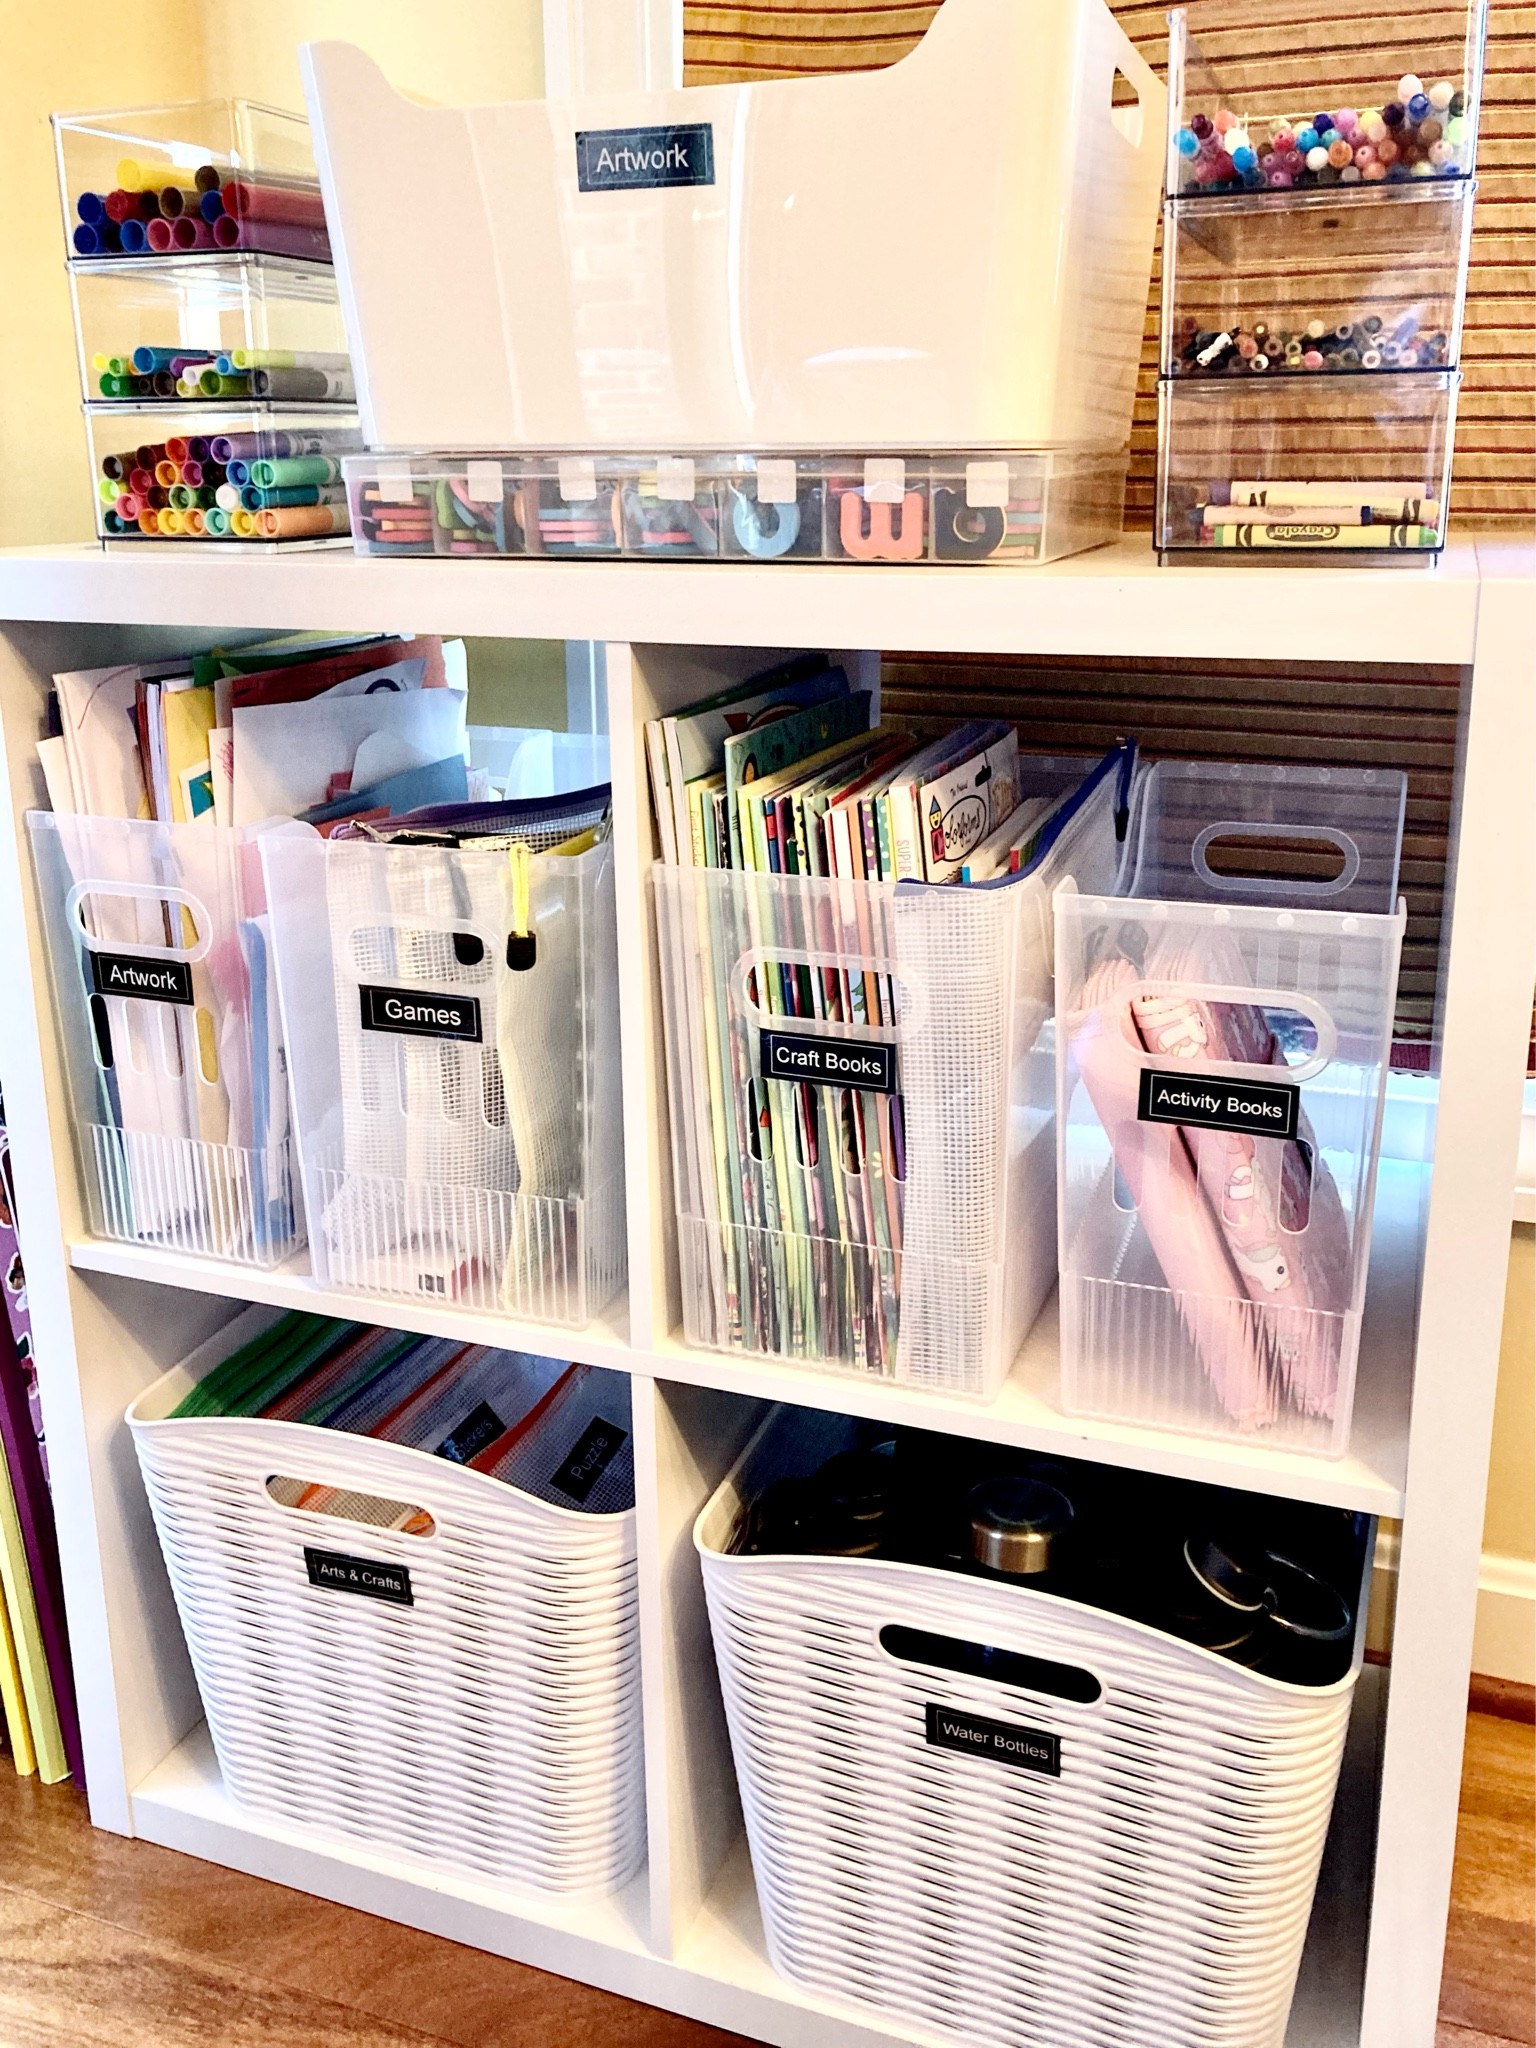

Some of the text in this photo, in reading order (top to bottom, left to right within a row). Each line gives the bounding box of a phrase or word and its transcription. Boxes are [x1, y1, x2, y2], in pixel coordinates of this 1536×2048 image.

[595, 142, 689, 173] Artwork
[109, 964, 178, 991] Artwork
[385, 999, 461, 1026] Games
[776, 1046, 882, 1075] Craft Books
[1157, 1089, 1283, 1118] Activity Books
[452, 1418, 493, 1459] Stickers
[570, 1435, 608, 1480] Puzzle
[320, 1563, 401, 1591] Arts & Crafts
[943, 1722, 1049, 1760] Water Bottles
